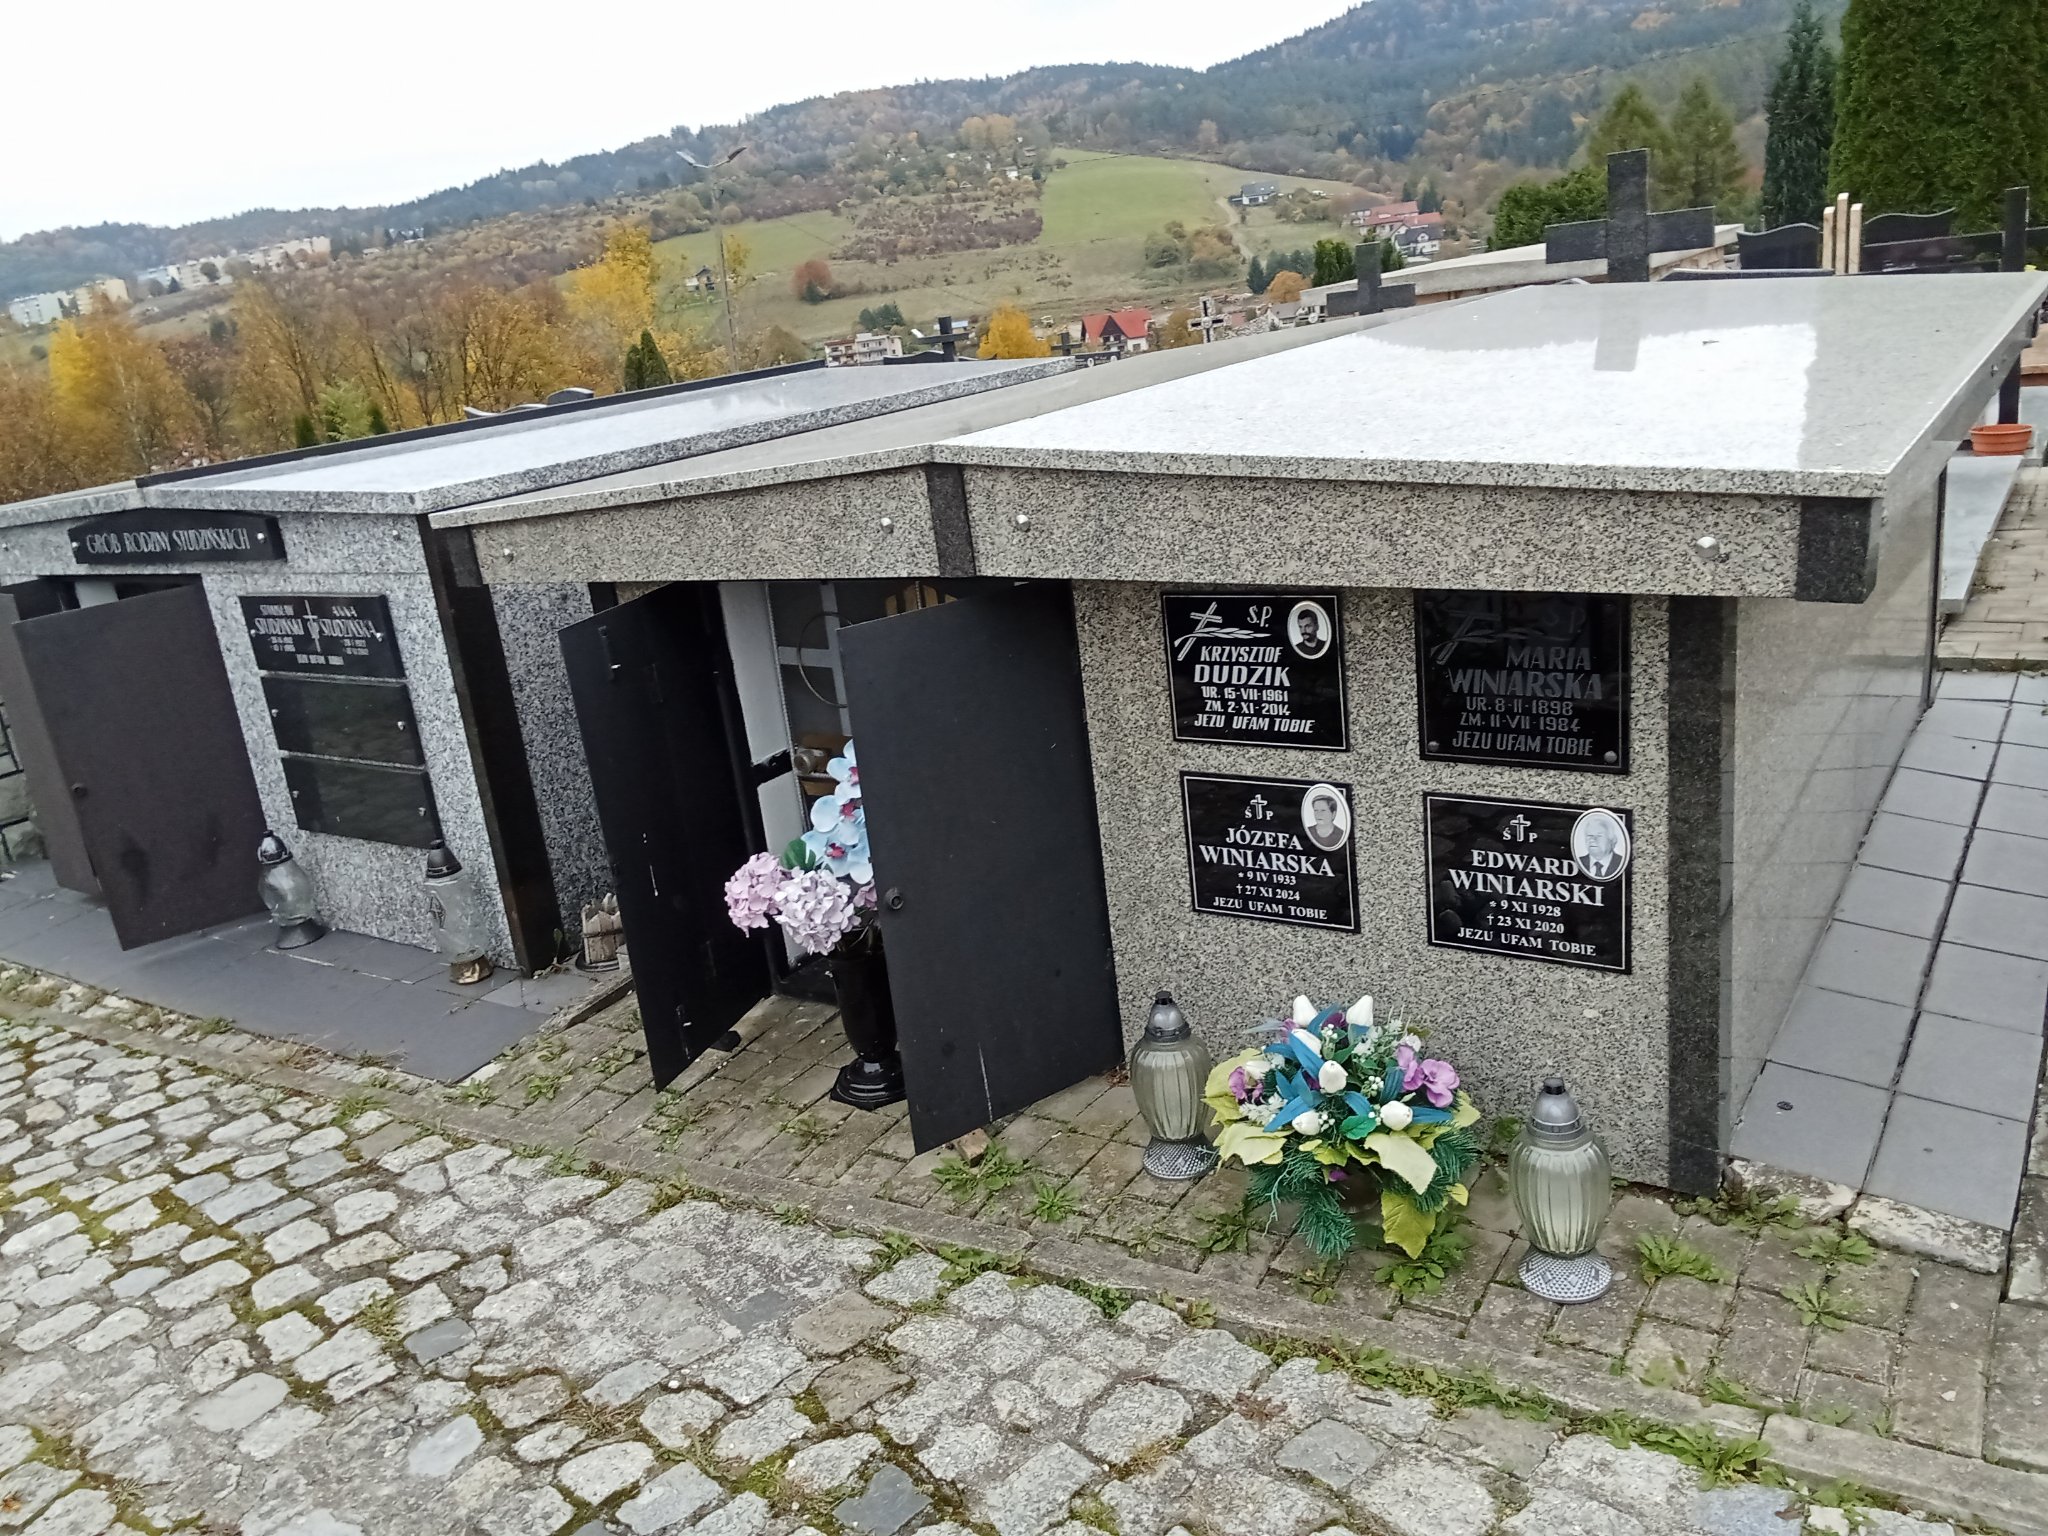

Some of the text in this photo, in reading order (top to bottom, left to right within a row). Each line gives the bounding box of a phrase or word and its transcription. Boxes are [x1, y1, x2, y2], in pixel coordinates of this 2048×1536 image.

[1200, 646, 1283, 663] KRZYSZTOF
[1506, 646, 1591, 671] MARIA
[1194, 664, 1291, 686] DUDZIK
[1448, 668, 1603, 700] WINIARSKA
[1201, 686, 1221, 699] UR.
[1205, 700, 1223, 712] ZM.
[1466, 697, 1491, 711] UR.
[1194, 714, 1315, 733] JEZU UFAM TOBIE
[1460, 712, 1486, 726] ZM.
[1452, 730, 1594, 756] JEZU UFAM TOBIE
[1226, 825, 1303, 851] JÓZEFA
[1199, 844, 1335, 877] WINIARSKA
[1471, 849, 1578, 877] EDWARD
[1247, 871, 1297, 885] 9 IV 1933
[1448, 868, 1605, 907] WINIARSKI
[1245, 885, 1301, 901] 27 XI 2024
[1213, 897, 1328, 919] JEZU UFAM TOBIE
[1501, 900, 1562, 917] 9 XI 1928
[1497, 915, 1565, 934] 23 XI 2020
[1457, 927, 1597, 957] JEZU UFAM TOBIE
